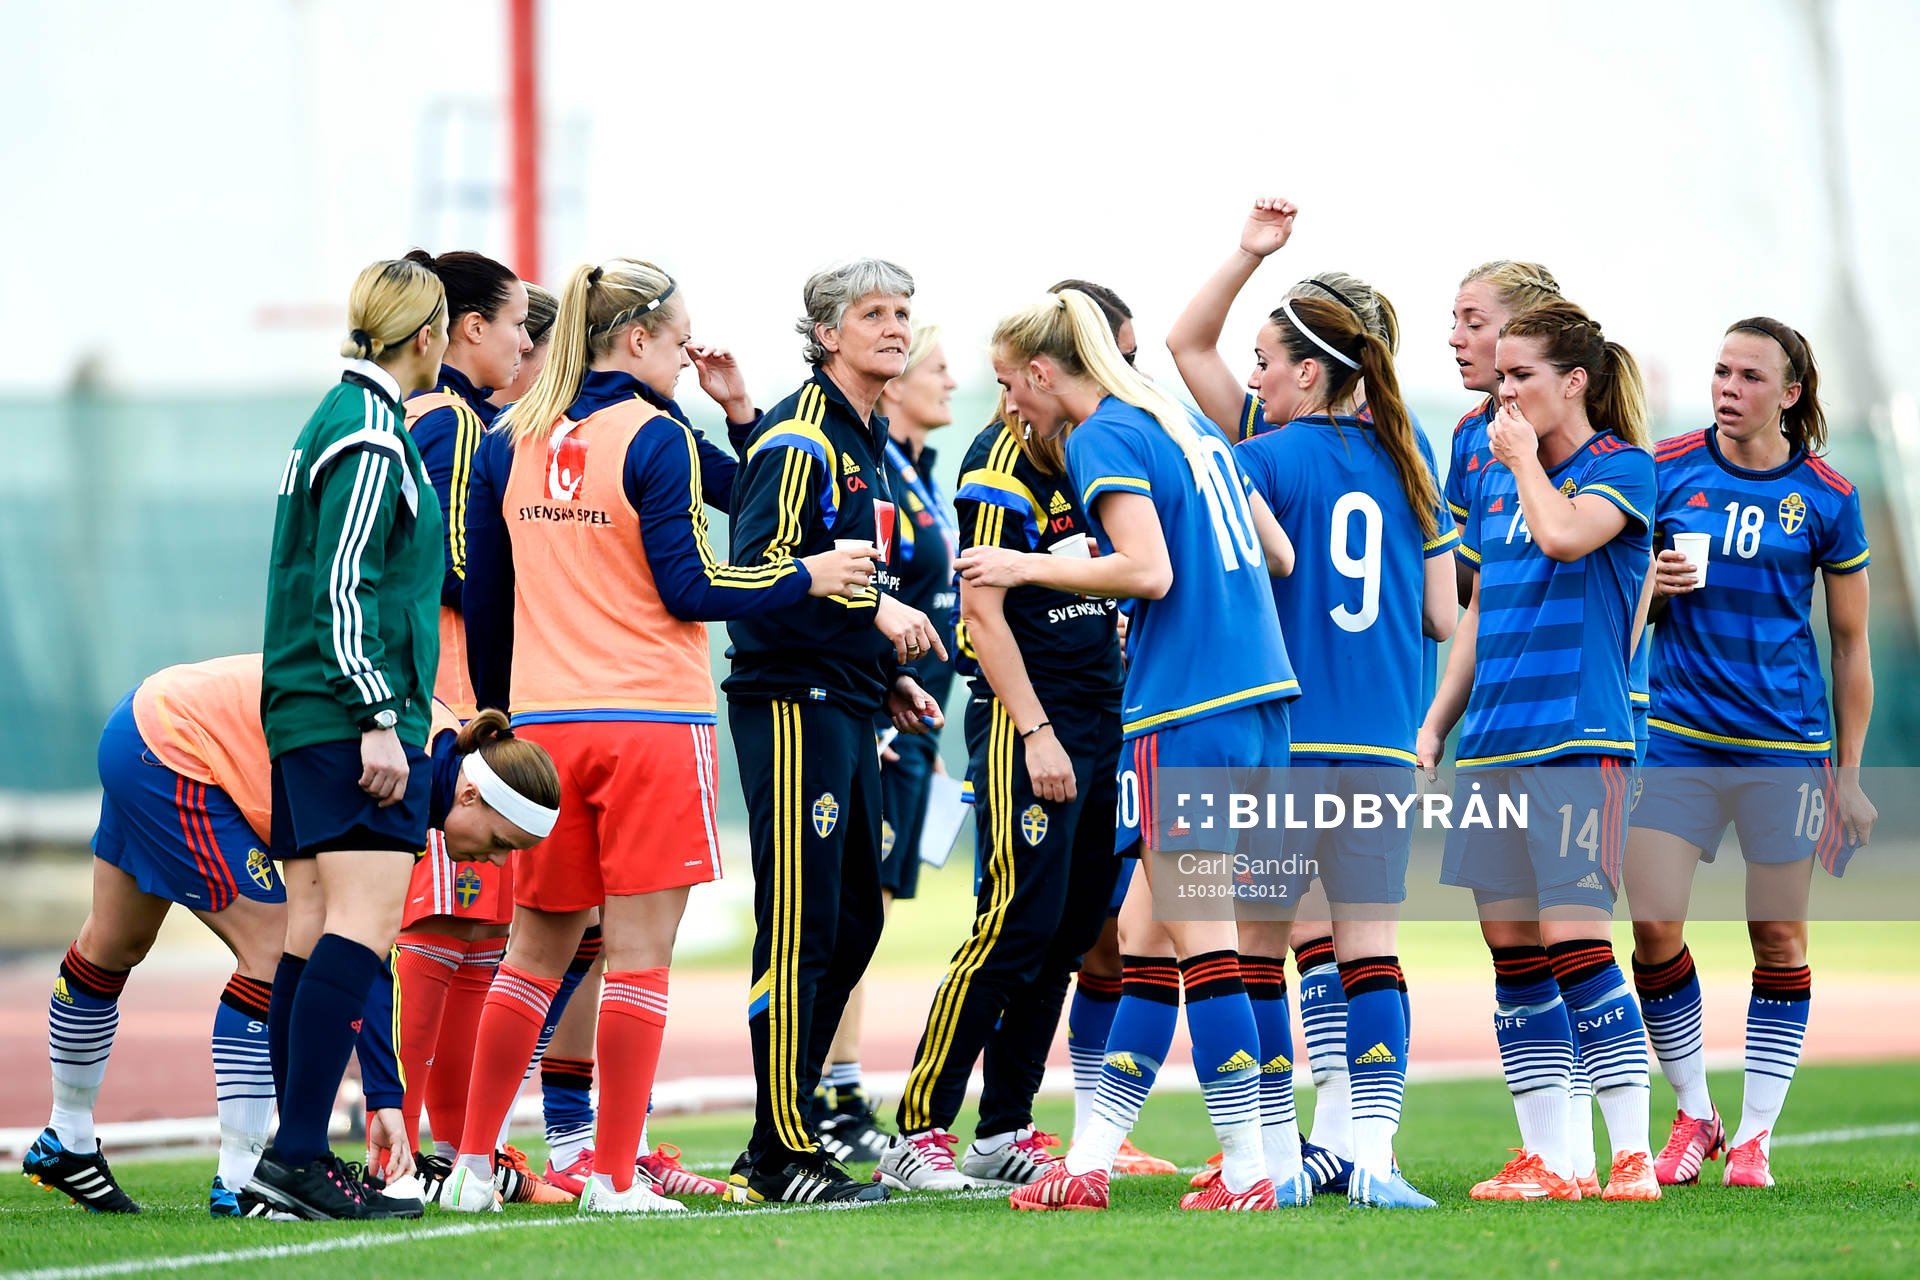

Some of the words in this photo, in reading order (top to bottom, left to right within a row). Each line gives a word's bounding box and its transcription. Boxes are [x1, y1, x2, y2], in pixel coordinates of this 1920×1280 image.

[519, 505, 575, 521] SVENSKA
[577, 508, 612, 524] SPEL
[1050, 515, 1074, 534] ICA
[1722, 501, 1765, 559] 18
[1329, 491, 1383, 632] 9
[1047, 602, 1107, 624] SVENSKA
[1794, 783, 1826, 841] 18
[1558, 804, 1599, 862] 14
[1301, 984, 1328, 1003] VFF
[1577, 1006, 1625, 1033] SVFF
[1217, 1059, 1258, 1073] adidas
[1355, 1055, 1397, 1064] adidas
